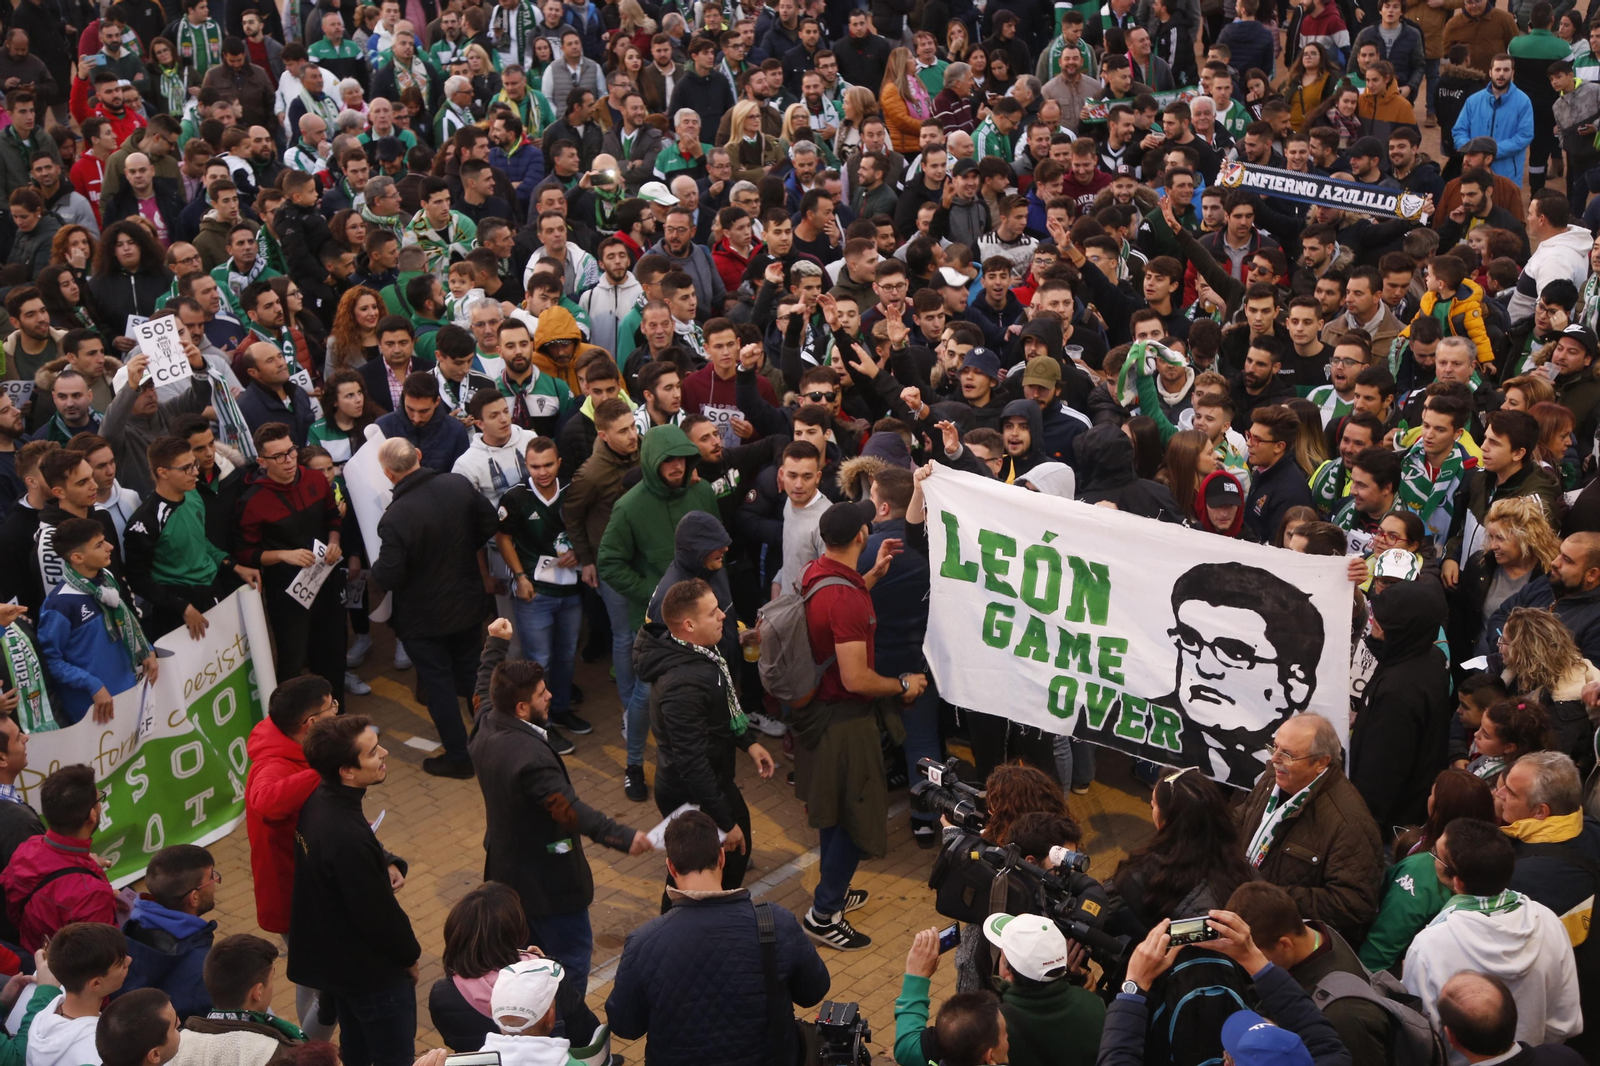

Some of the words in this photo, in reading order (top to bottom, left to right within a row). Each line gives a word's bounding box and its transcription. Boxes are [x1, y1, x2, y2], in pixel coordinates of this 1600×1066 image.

[1242, 171, 1318, 197] INFIERNO
[1319, 184, 1398, 211] AZULILLO
[141, 319, 173, 340] SOS
[156, 360, 187, 381] CCF
[939, 510, 1112, 626] LEÓN
[292, 581, 315, 602] CCF
[9, 640, 31, 690] TRUPE
[982, 601, 1128, 686] GAME
[1047, 675, 1183, 753] OVER
